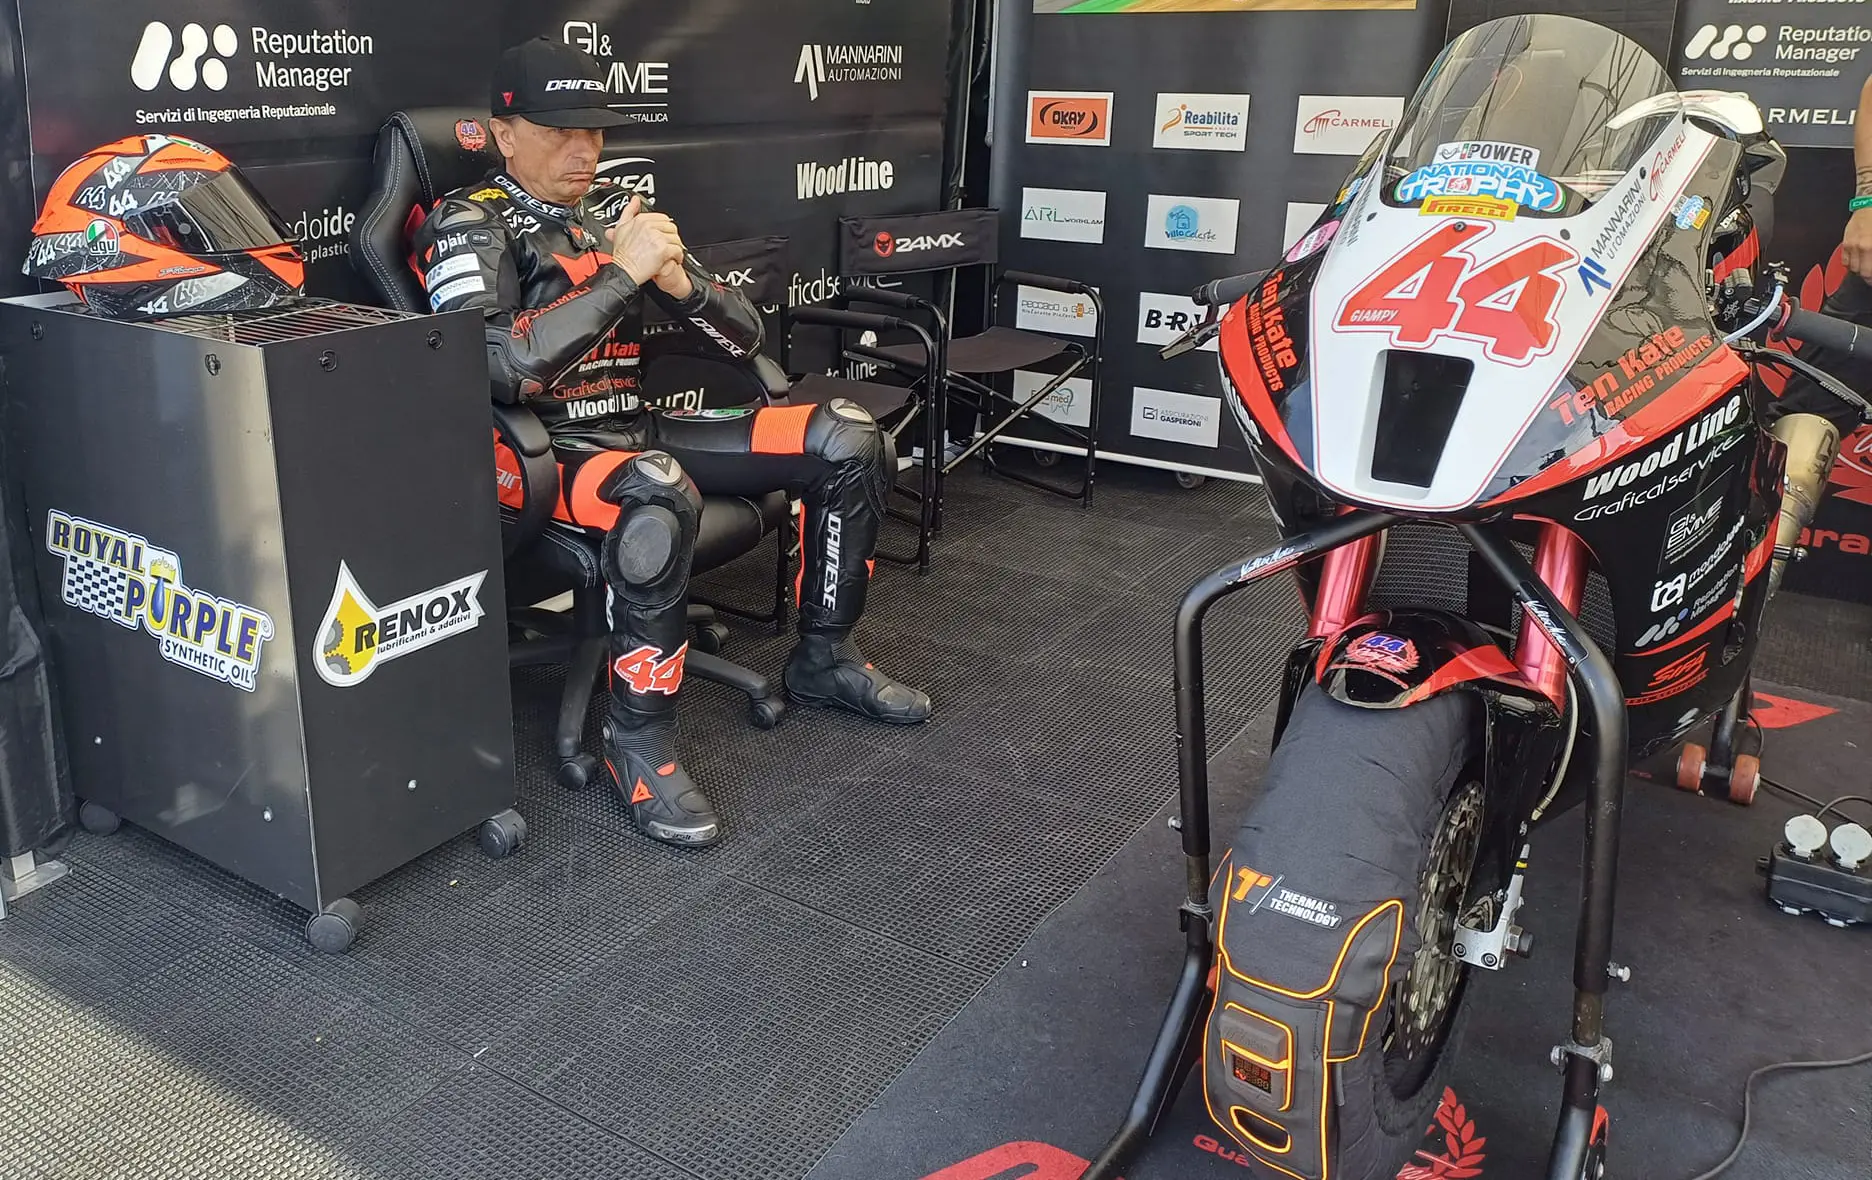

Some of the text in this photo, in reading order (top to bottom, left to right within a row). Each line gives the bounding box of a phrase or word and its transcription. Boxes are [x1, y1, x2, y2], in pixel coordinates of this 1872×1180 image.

[251, 27, 373, 58] Reputation
[1778, 25, 1872, 45] Reputatio
[826, 45, 903, 65] MANNARINI
[1775, 44, 1861, 63] Manager
[255, 61, 353, 92] Manager
[827, 67, 902, 82] AUTOMAZIONI
[1681, 67, 1840, 78] Servizi di Ingegneria Reputazionale
[135, 103, 336, 124] Servizi di Ingegneria Reputazionale
[625, 113, 669, 123] ETALLICA
[1053, 110, 1086, 126] OKAY
[1184, 110, 1238, 126] Reabilita
[1330, 118, 1394, 128] CARMELI
[1767, 108, 1857, 125] RMELI
[1215, 131, 1238, 139] TECH
[1468, 143, 1534, 166] POWER
[1660, 130, 1687, 175] CARMELI
[1420, 164, 1545, 188] NATIONAL
[494, 174, 565, 218] DAINESE
[1426, 199, 1509, 218] PIRELLI
[1024, 206, 1064, 223] ARL
[1591, 176, 1642, 259] MANNARINI
[895, 232, 965, 253] 24MX
[1333, 219, 1578, 366] 44
[1350, 308, 1399, 323] GIAMPY
[688, 316, 747, 358] DAINESE
[1249, 302, 1284, 392] ACING PRODUCTS
[1264, 306, 1298, 369] Kate
[1550, 325, 1686, 427] Ten Kate
[1604, 334, 1713, 418] RACING PRODUCTS
[1160, 415, 1202, 427] GASPERONI
[1582, 432, 1684, 501] Wood
[1685, 394, 1741, 456] Line
[53, 518, 145, 575] ROYAL
[823, 512, 841, 611] DAINESE
[123, 572, 261, 665] PURPLE
[354, 586, 472, 655] RENOX
[377, 611, 471, 655] lubrificanti & additivi
[164, 638, 251, 684] SYNTHETIC OIL
[614, 640, 688, 695] 44
[1270, 897, 1340, 928] TECHNOLOGY
[1279, 889, 1329, 914] THERMAL
